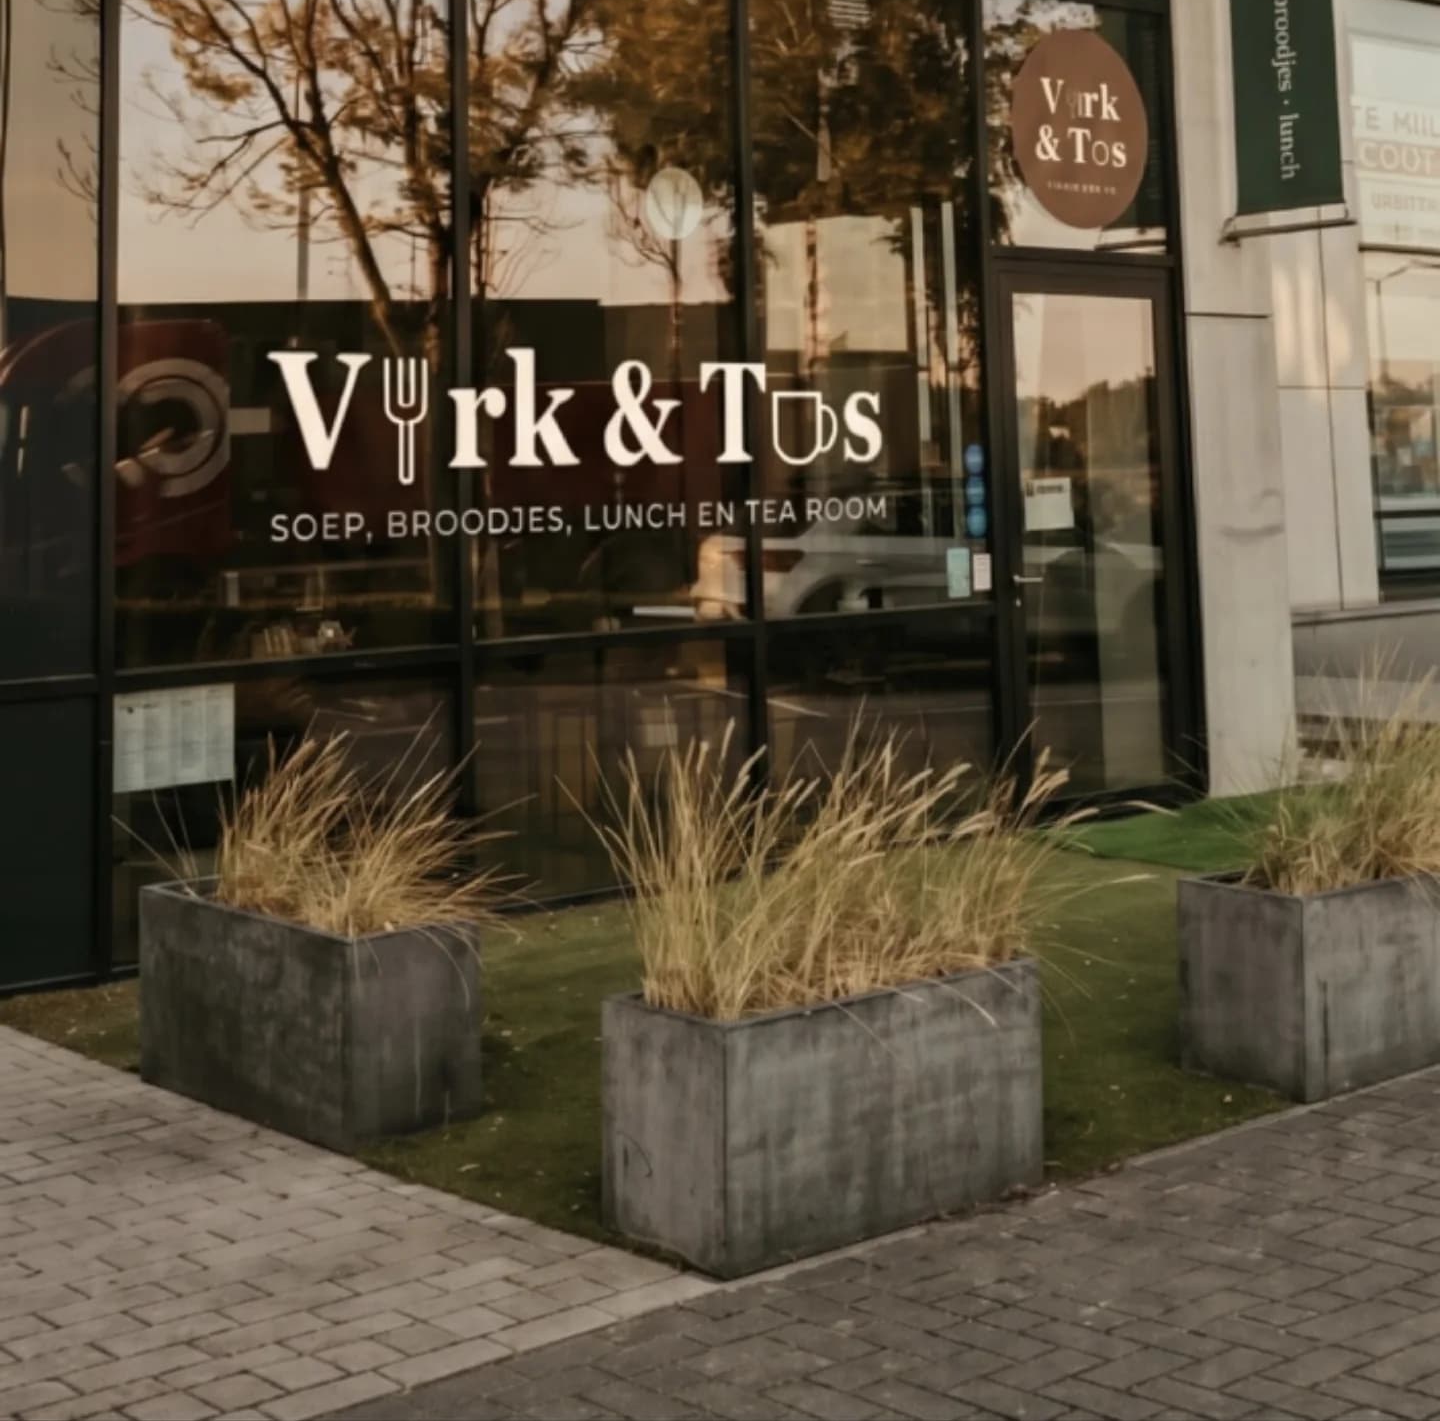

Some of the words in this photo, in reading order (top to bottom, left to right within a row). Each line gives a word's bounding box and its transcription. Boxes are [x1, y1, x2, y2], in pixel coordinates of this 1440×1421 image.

[1040, 77, 1121, 122] Vrk
[1035, 125, 1062, 162] &
[1279, 111, 1302, 181] lunch
[267, 347, 581, 486] Vrk
[603, 360, 683, 466] &
[699, 362, 883, 465] Ts
[270, 513, 373, 544] SOEP,
[387, 506, 572, 540] BROODJES,
[585, 502, 686, 532] LUNCH
[699, 501, 735, 527] EN
[745, 498, 798, 524] TEA
[806, 495, 888, 522] ROOM
